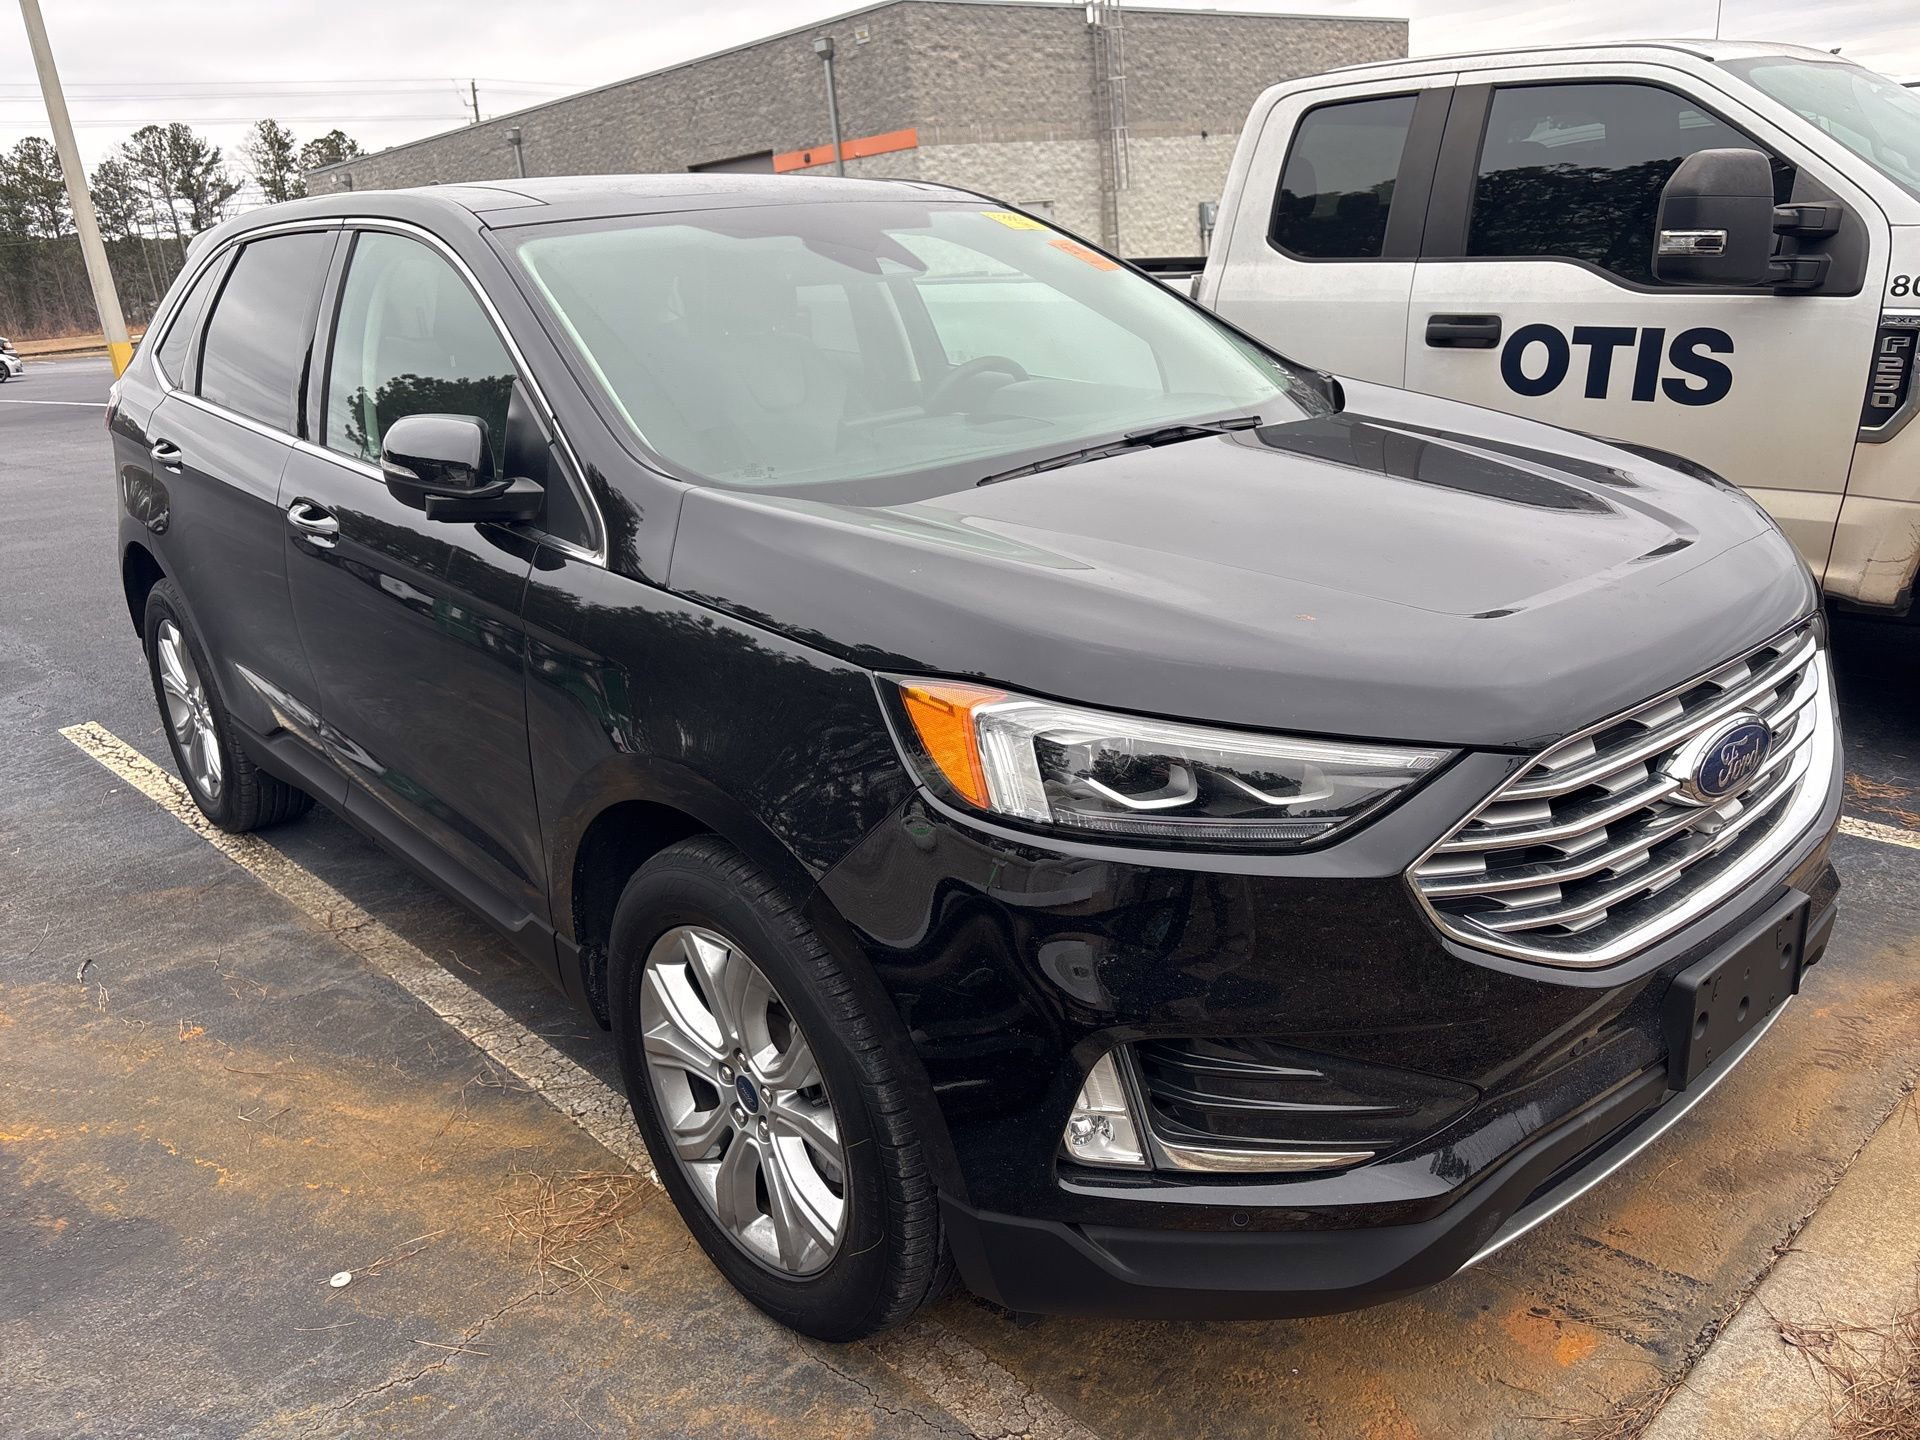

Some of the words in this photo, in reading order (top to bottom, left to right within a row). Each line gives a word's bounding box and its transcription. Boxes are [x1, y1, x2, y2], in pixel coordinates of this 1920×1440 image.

[1500, 323, 1735, 407] OTIS
[1870, 336, 1911, 408] F250
[1719, 735, 1760, 788] Ford
